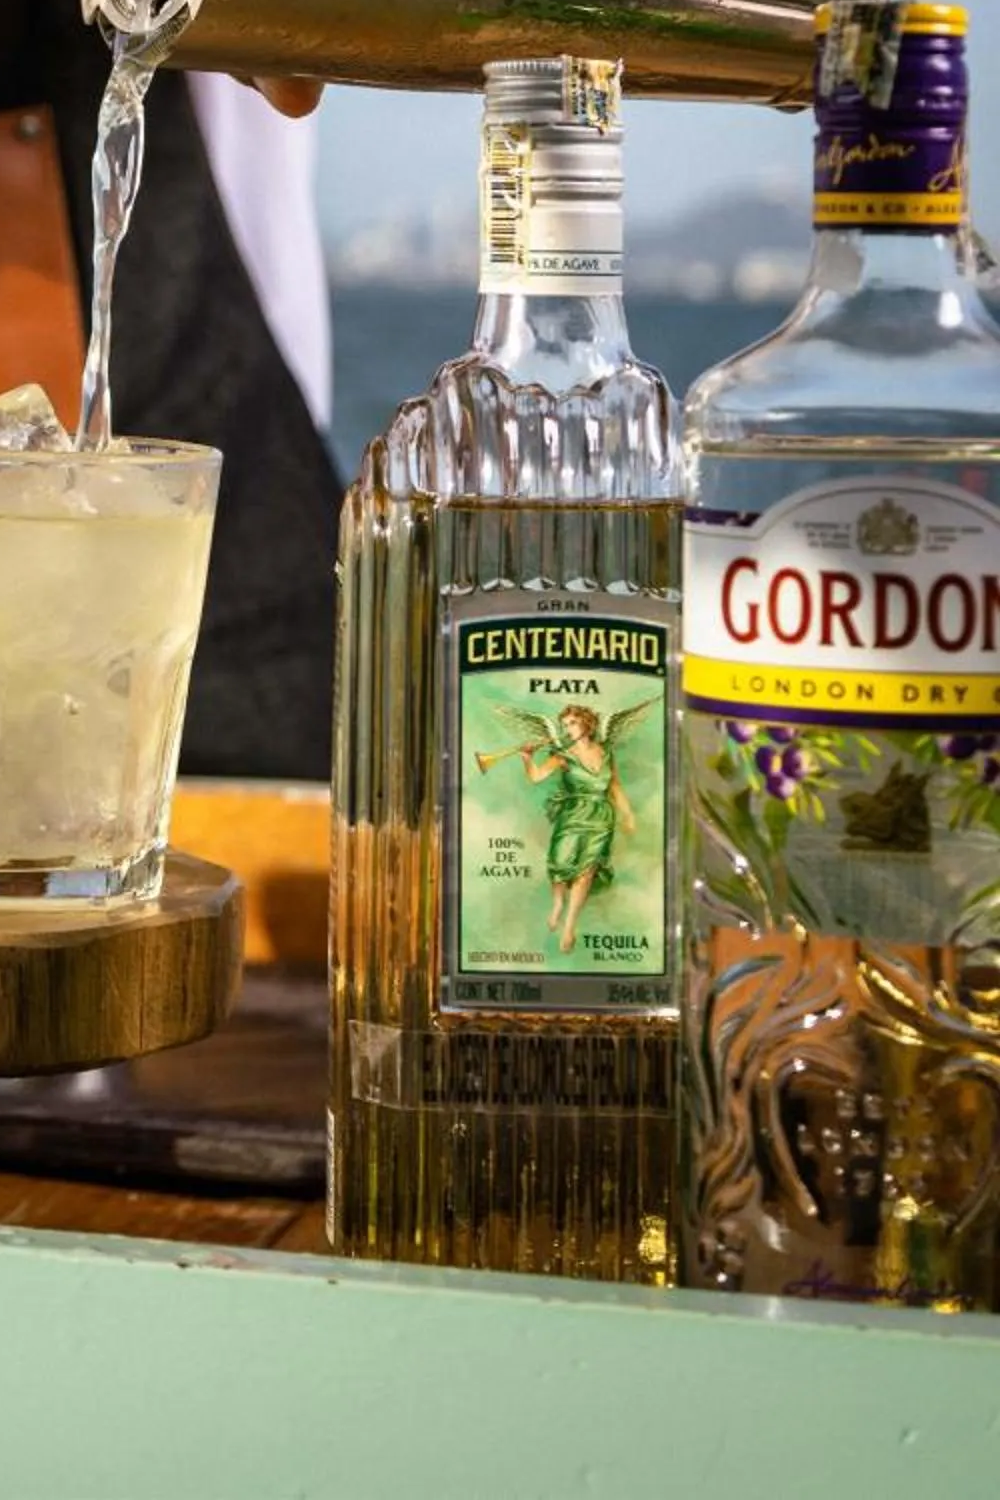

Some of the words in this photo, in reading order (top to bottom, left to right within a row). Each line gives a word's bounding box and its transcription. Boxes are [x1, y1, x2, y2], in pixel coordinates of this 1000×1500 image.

[536, 599, 591, 612] GRAN
[466, 627, 659, 667] CENTENARIO
[528, 677, 601, 695] PLATA
[731, 675, 876, 701] LONDON
[902, 683, 969, 704] DRY
[487, 837, 525, 850] 100%
[495, 851, 518, 863] DE
[480, 865, 532, 879] AGAVE
[583, 934, 649, 950] TEQUILA
[593, 952, 644, 963] BLANCO
